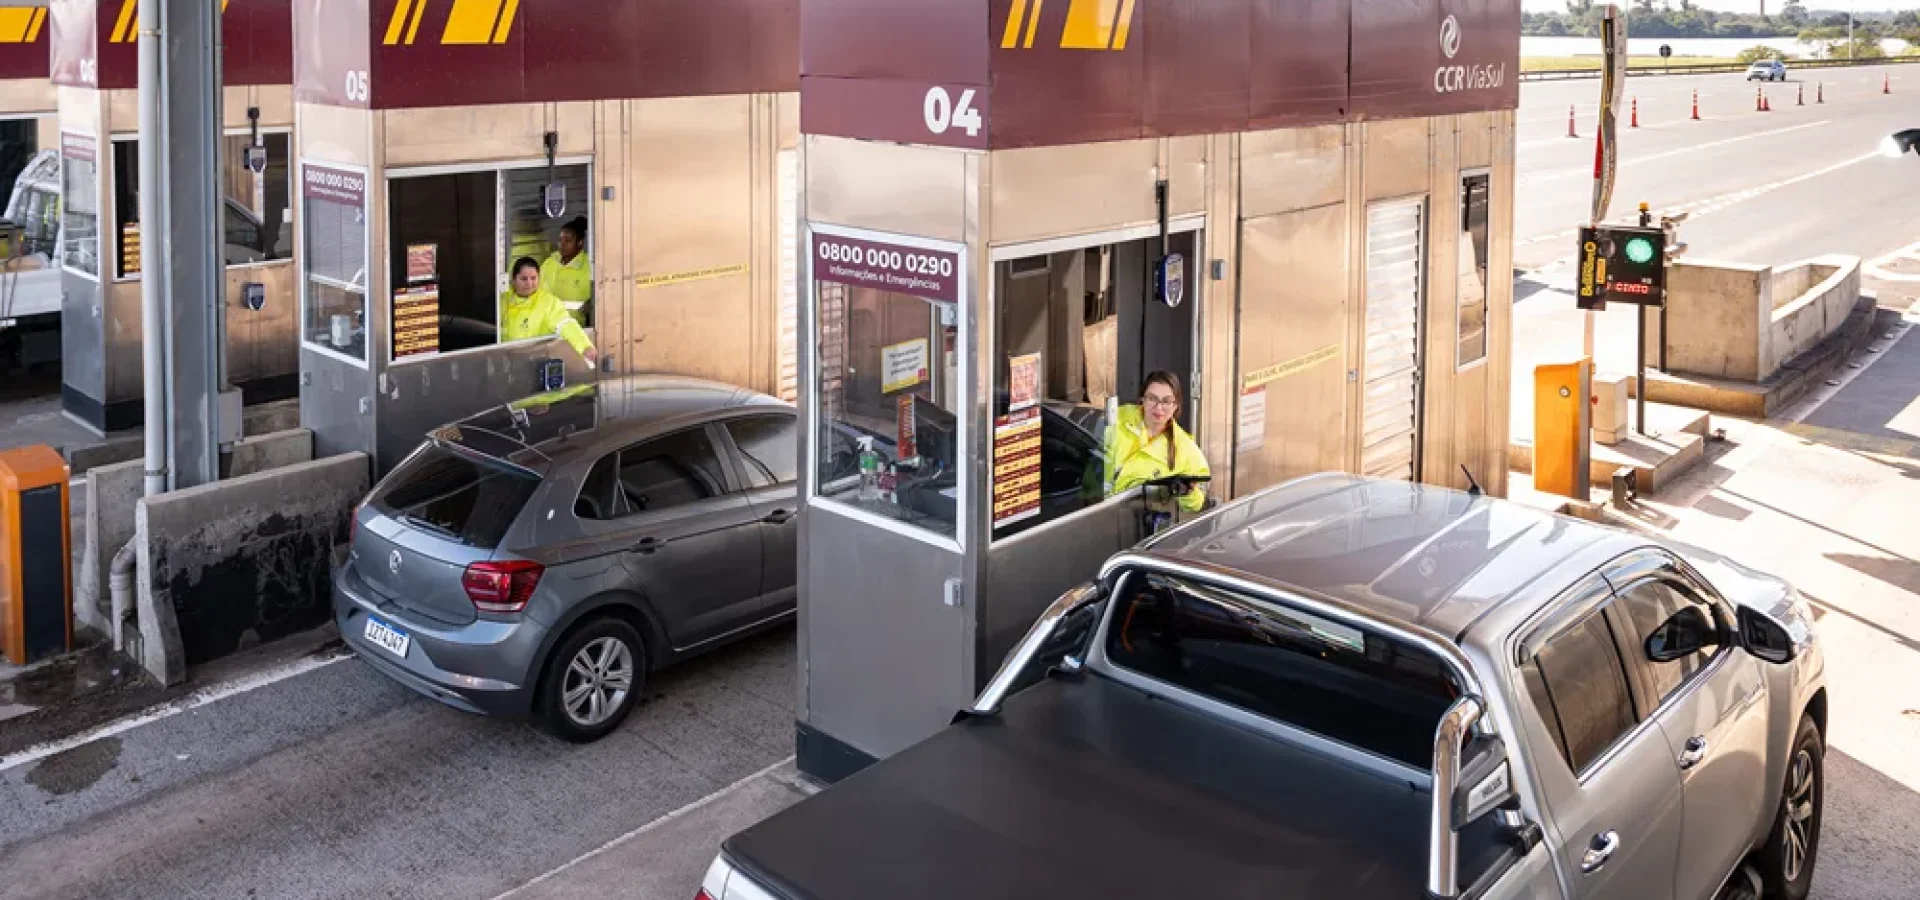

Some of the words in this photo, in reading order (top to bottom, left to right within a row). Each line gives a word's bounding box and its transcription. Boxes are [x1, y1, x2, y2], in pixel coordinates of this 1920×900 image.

[345, 70, 368, 102] 05
[1434, 66, 1464, 92] CCR
[1466, 61, 1505, 89] ViaSul
[924, 85, 982, 136] 04
[819, 241, 863, 264] 0800
[866, 248, 901, 270] 000
[905, 253, 952, 277] 0290
[829, 264, 878, 282] Informações
[879, 273, 885, 283] e
[886, 273, 941, 291] Emergências
